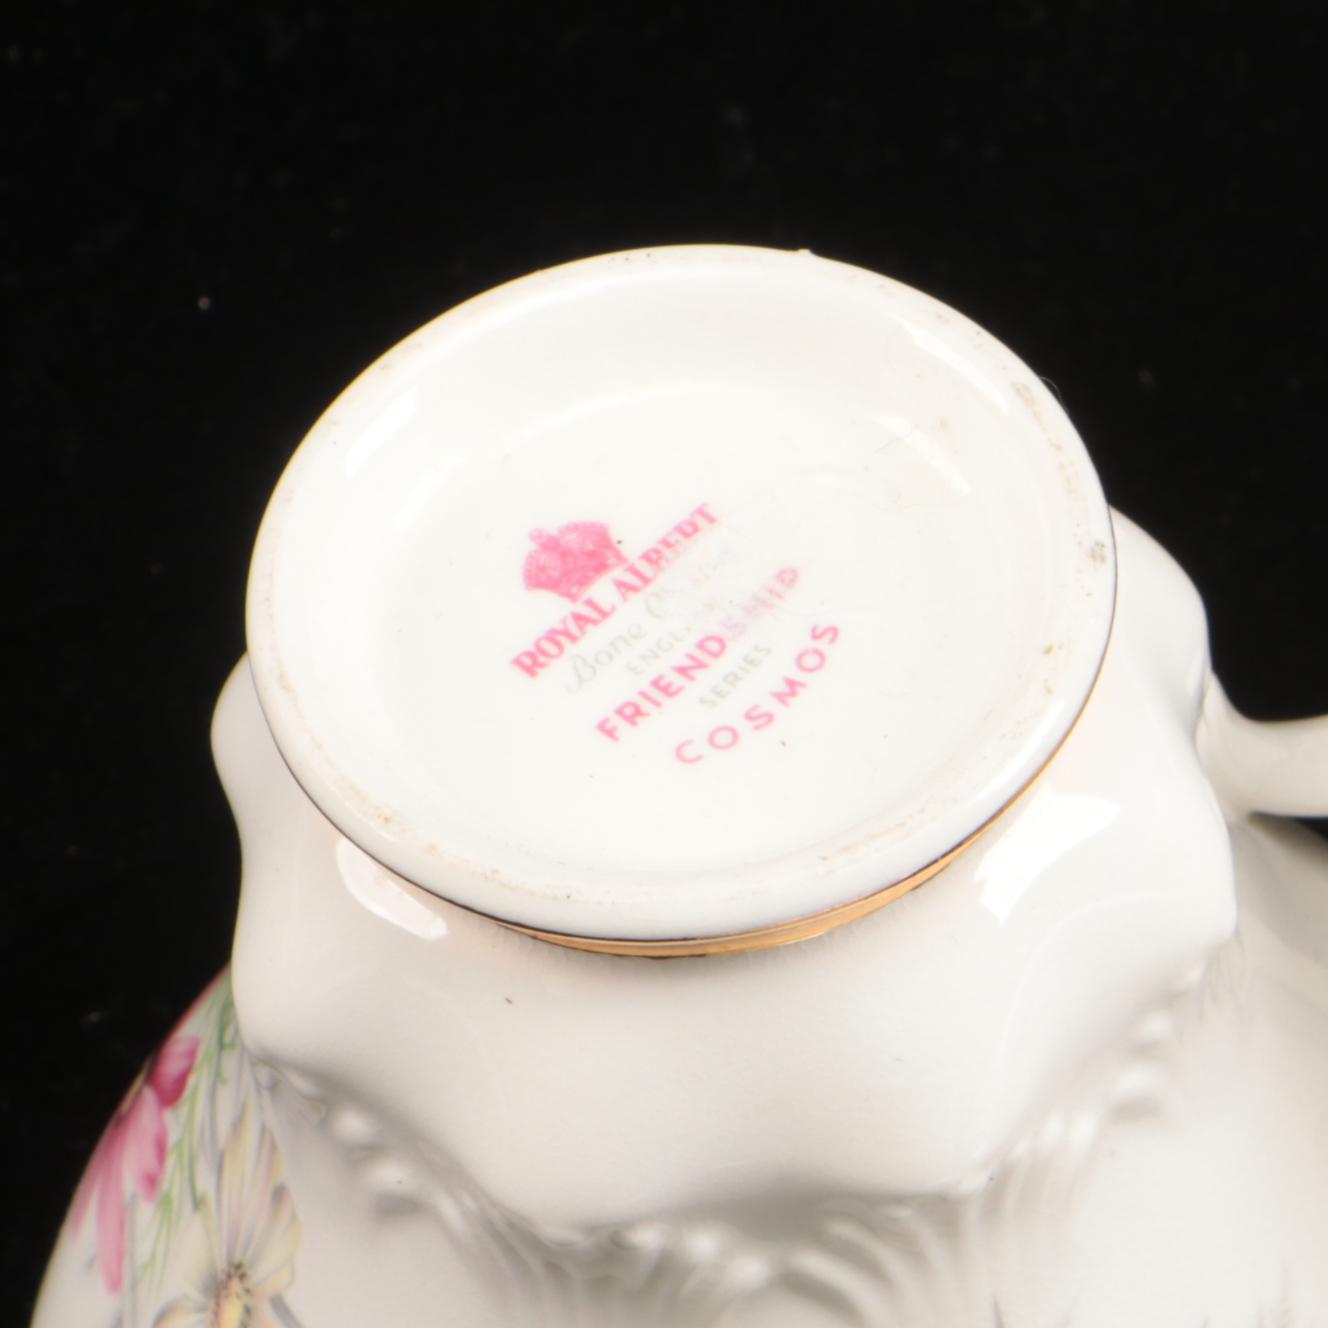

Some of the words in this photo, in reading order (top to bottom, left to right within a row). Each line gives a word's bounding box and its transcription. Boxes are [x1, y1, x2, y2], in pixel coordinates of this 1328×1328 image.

[511, 596, 617, 678] ROYAL
[564, 622, 646, 694] Bone
[674, 624, 840, 764] COSMOS
[698, 643, 773, 709] SERIES
